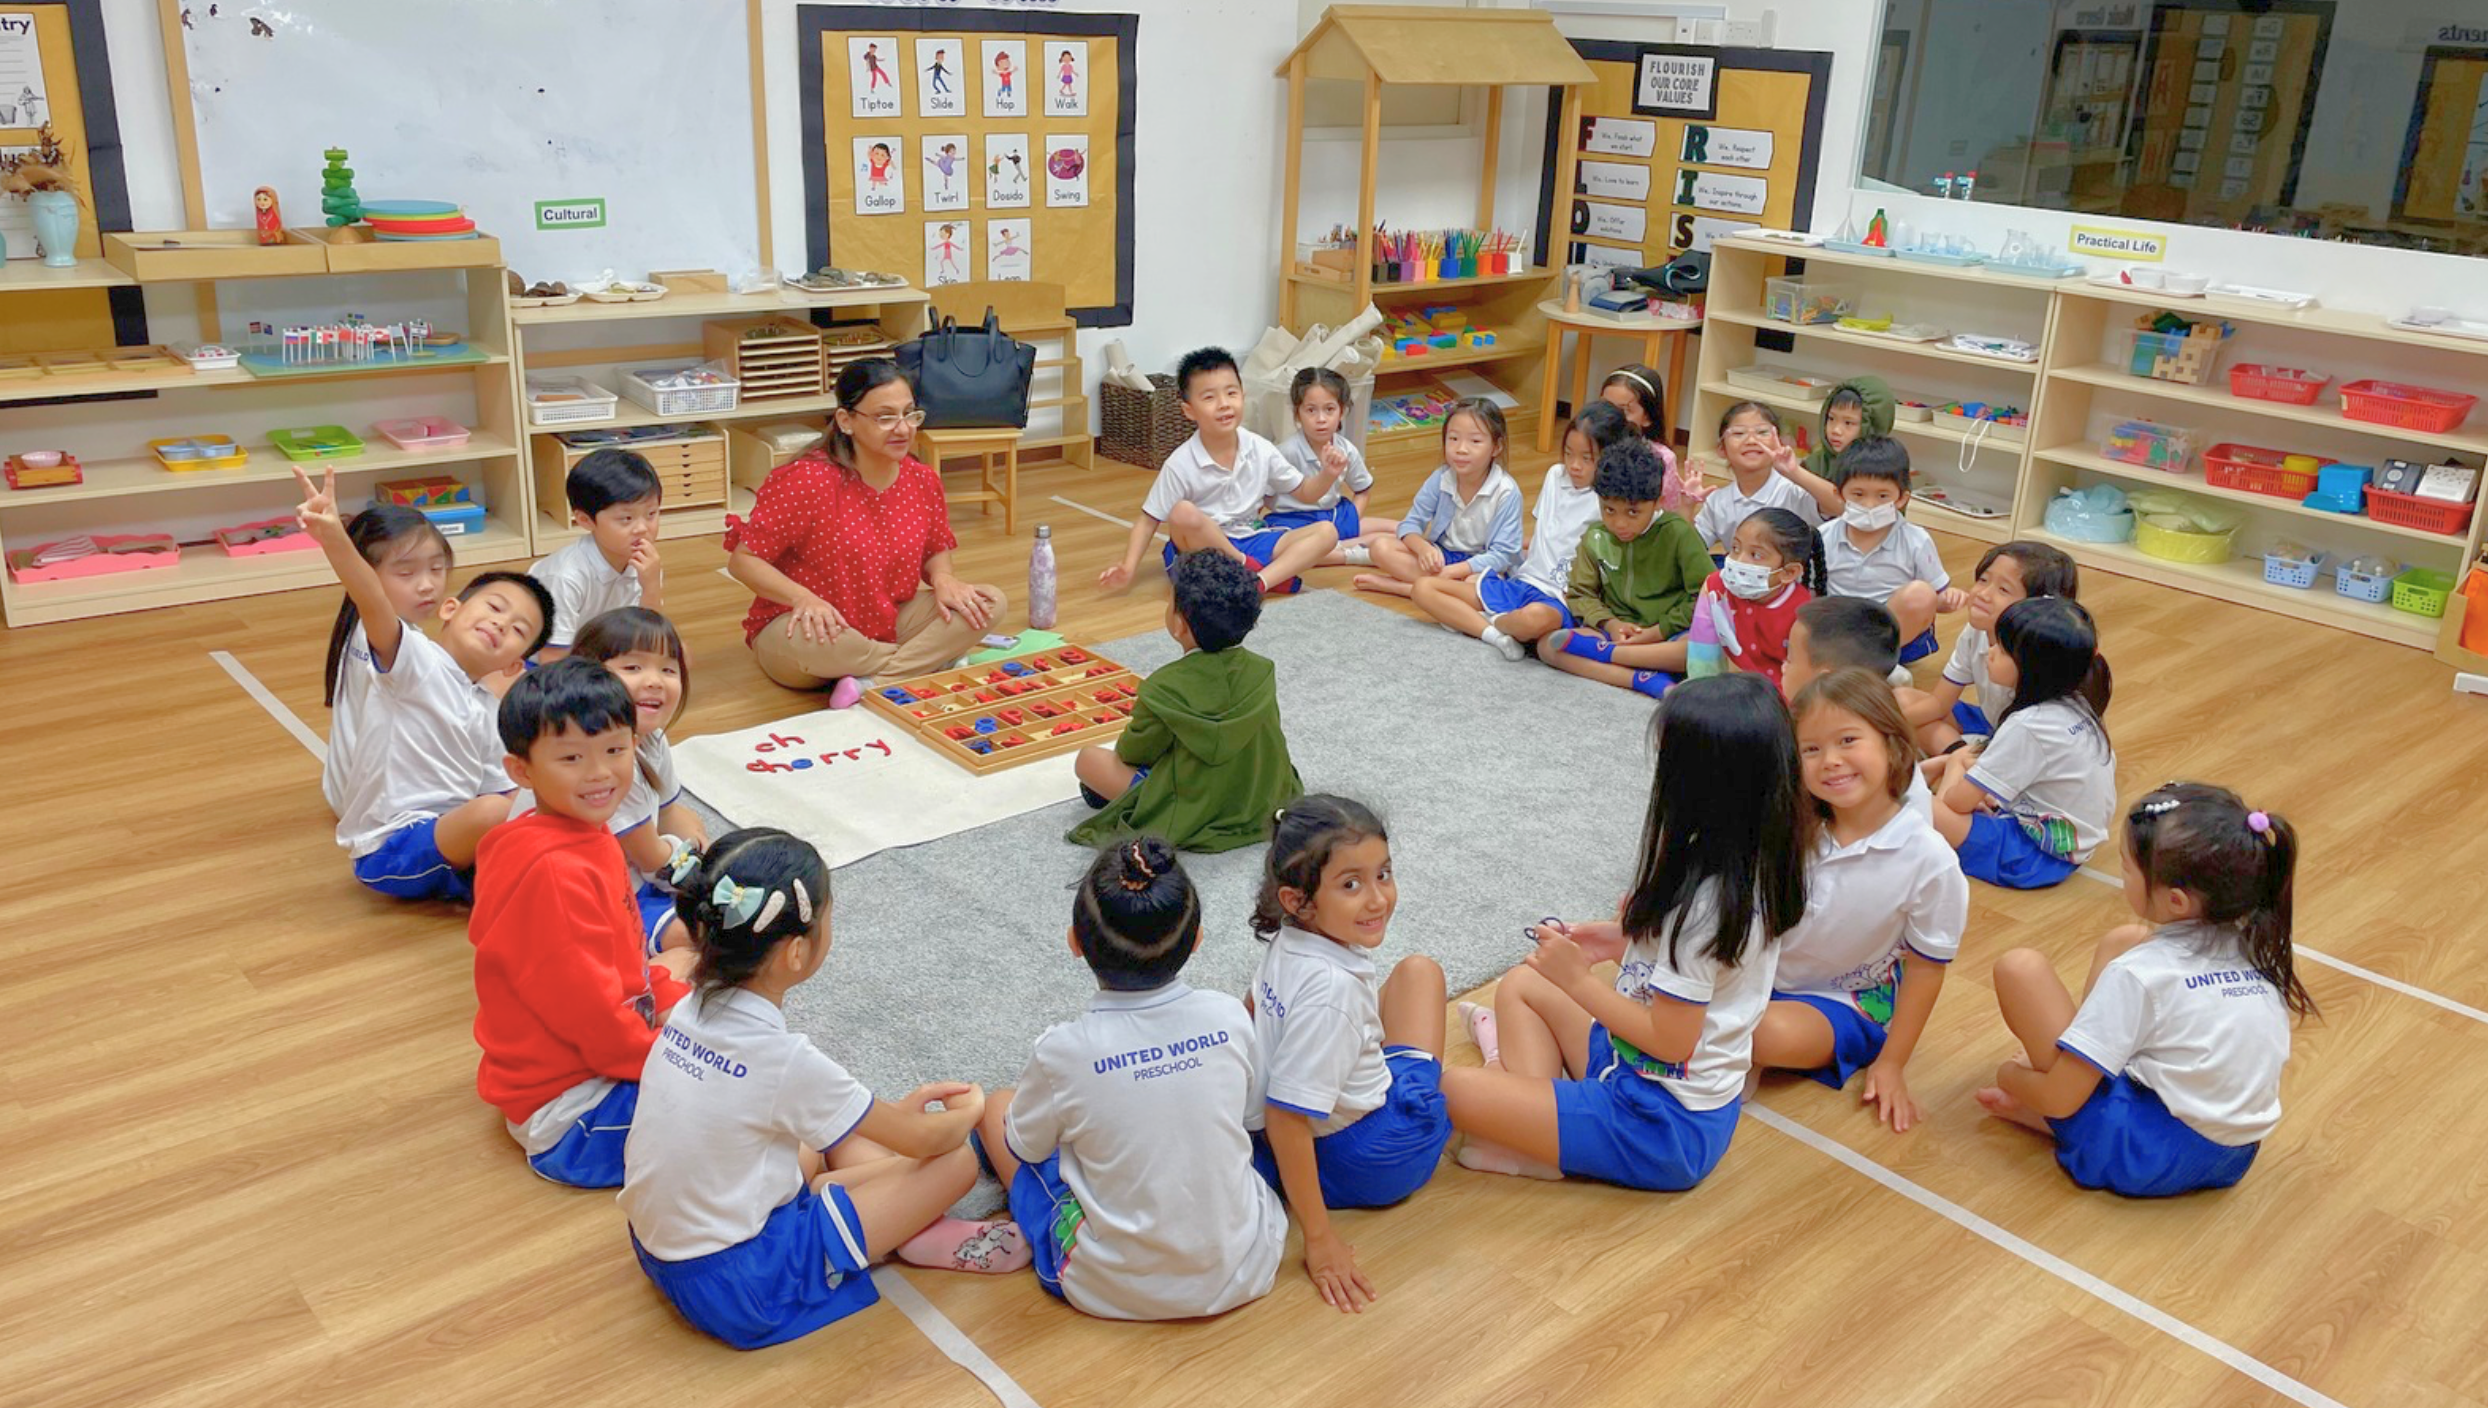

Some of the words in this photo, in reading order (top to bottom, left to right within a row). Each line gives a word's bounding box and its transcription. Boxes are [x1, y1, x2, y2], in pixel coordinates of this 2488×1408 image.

[0, 17, 30, 35] try
[1649, 60, 1706, 77] FLOURISH
[1650, 76, 1671, 90] OUR
[1672, 77, 1700, 92] CORE
[860, 97, 894, 111] Tiptoe
[930, 97, 954, 110] Slide
[996, 98, 1015, 111] Hop
[1054, 98, 1079, 110] Walk
[1656, 90, 1694, 105] VALUES
[1684, 124, 1709, 162] R
[993, 189, 1024, 202] Dosido
[1054, 189, 1080, 202] Swing
[1677, 169, 1699, 206] I
[865, 195, 896, 209] Gallop
[934, 191, 959, 204] Twirl
[544, 206, 598, 221] Cultural
[1674, 214, 1695, 248] S
[2077, 233, 2130, 250] Practical
[2132, 240, 2158, 253] Life
[755, 733, 806, 752] ch
[2185, 971, 2241, 989] UNITED
[2221, 985, 2269, 998] PRESCHOOL
[662, 1024, 691, 1051] NITED
[692, 1042, 748, 1079] WORLD
[1093, 1047, 1164, 1075] UNITED
[1167, 1030, 1230, 1057] WORLD
[662, 1046, 706, 1082] PRESCHOOL
[1133, 1056, 1204, 1081] PRESCHOOL
